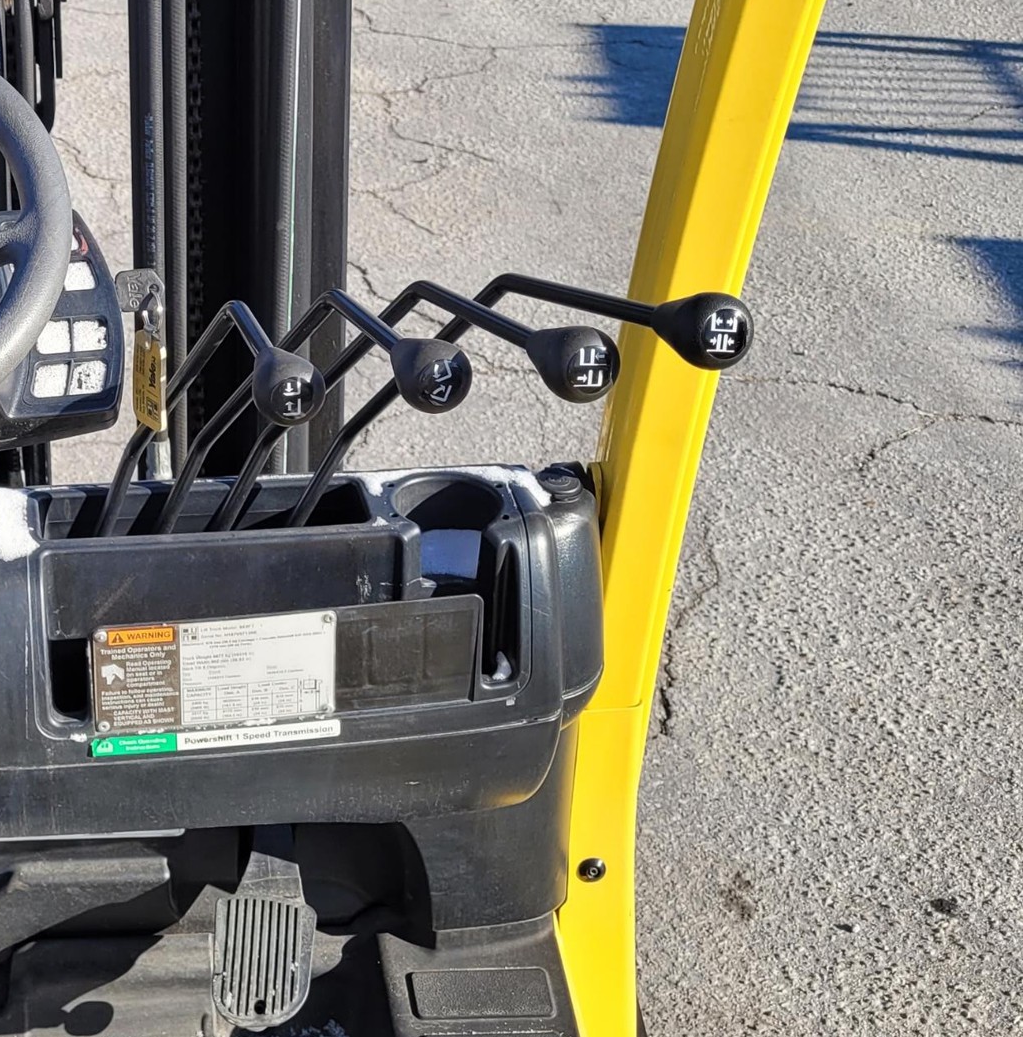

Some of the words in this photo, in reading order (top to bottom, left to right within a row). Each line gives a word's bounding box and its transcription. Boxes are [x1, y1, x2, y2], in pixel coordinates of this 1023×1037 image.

[127, 272, 144, 309] Yale
[127, 630, 171, 640] WARNING
[184, 735, 233, 745] Powershift
[242, 731, 271, 741] Speed
[274, 725, 334, 737] Transmission
